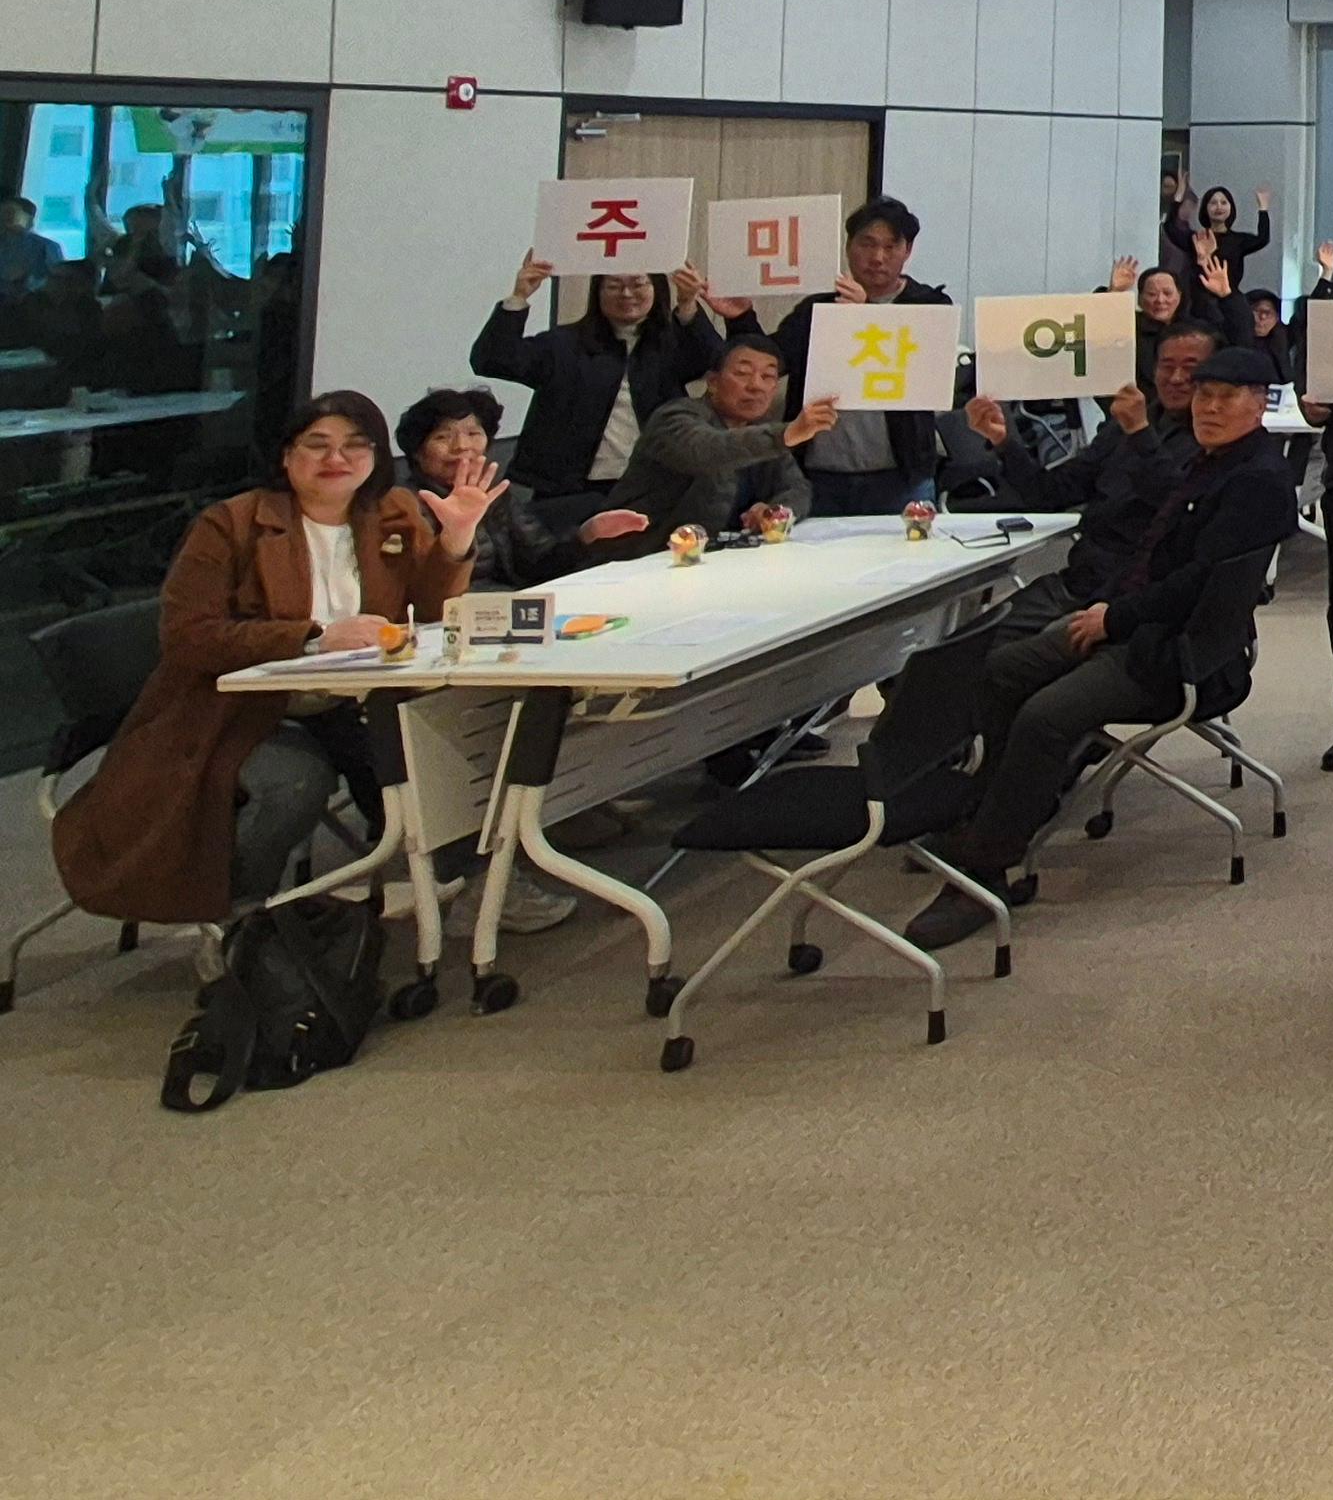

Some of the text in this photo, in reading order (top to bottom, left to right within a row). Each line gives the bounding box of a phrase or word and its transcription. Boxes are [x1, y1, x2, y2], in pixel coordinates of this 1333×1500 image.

[577, 200, 647, 258] 주
[748, 216, 801, 286] 민
[847, 323, 918, 400] 참
[1023, 313, 1087, 377] 여
